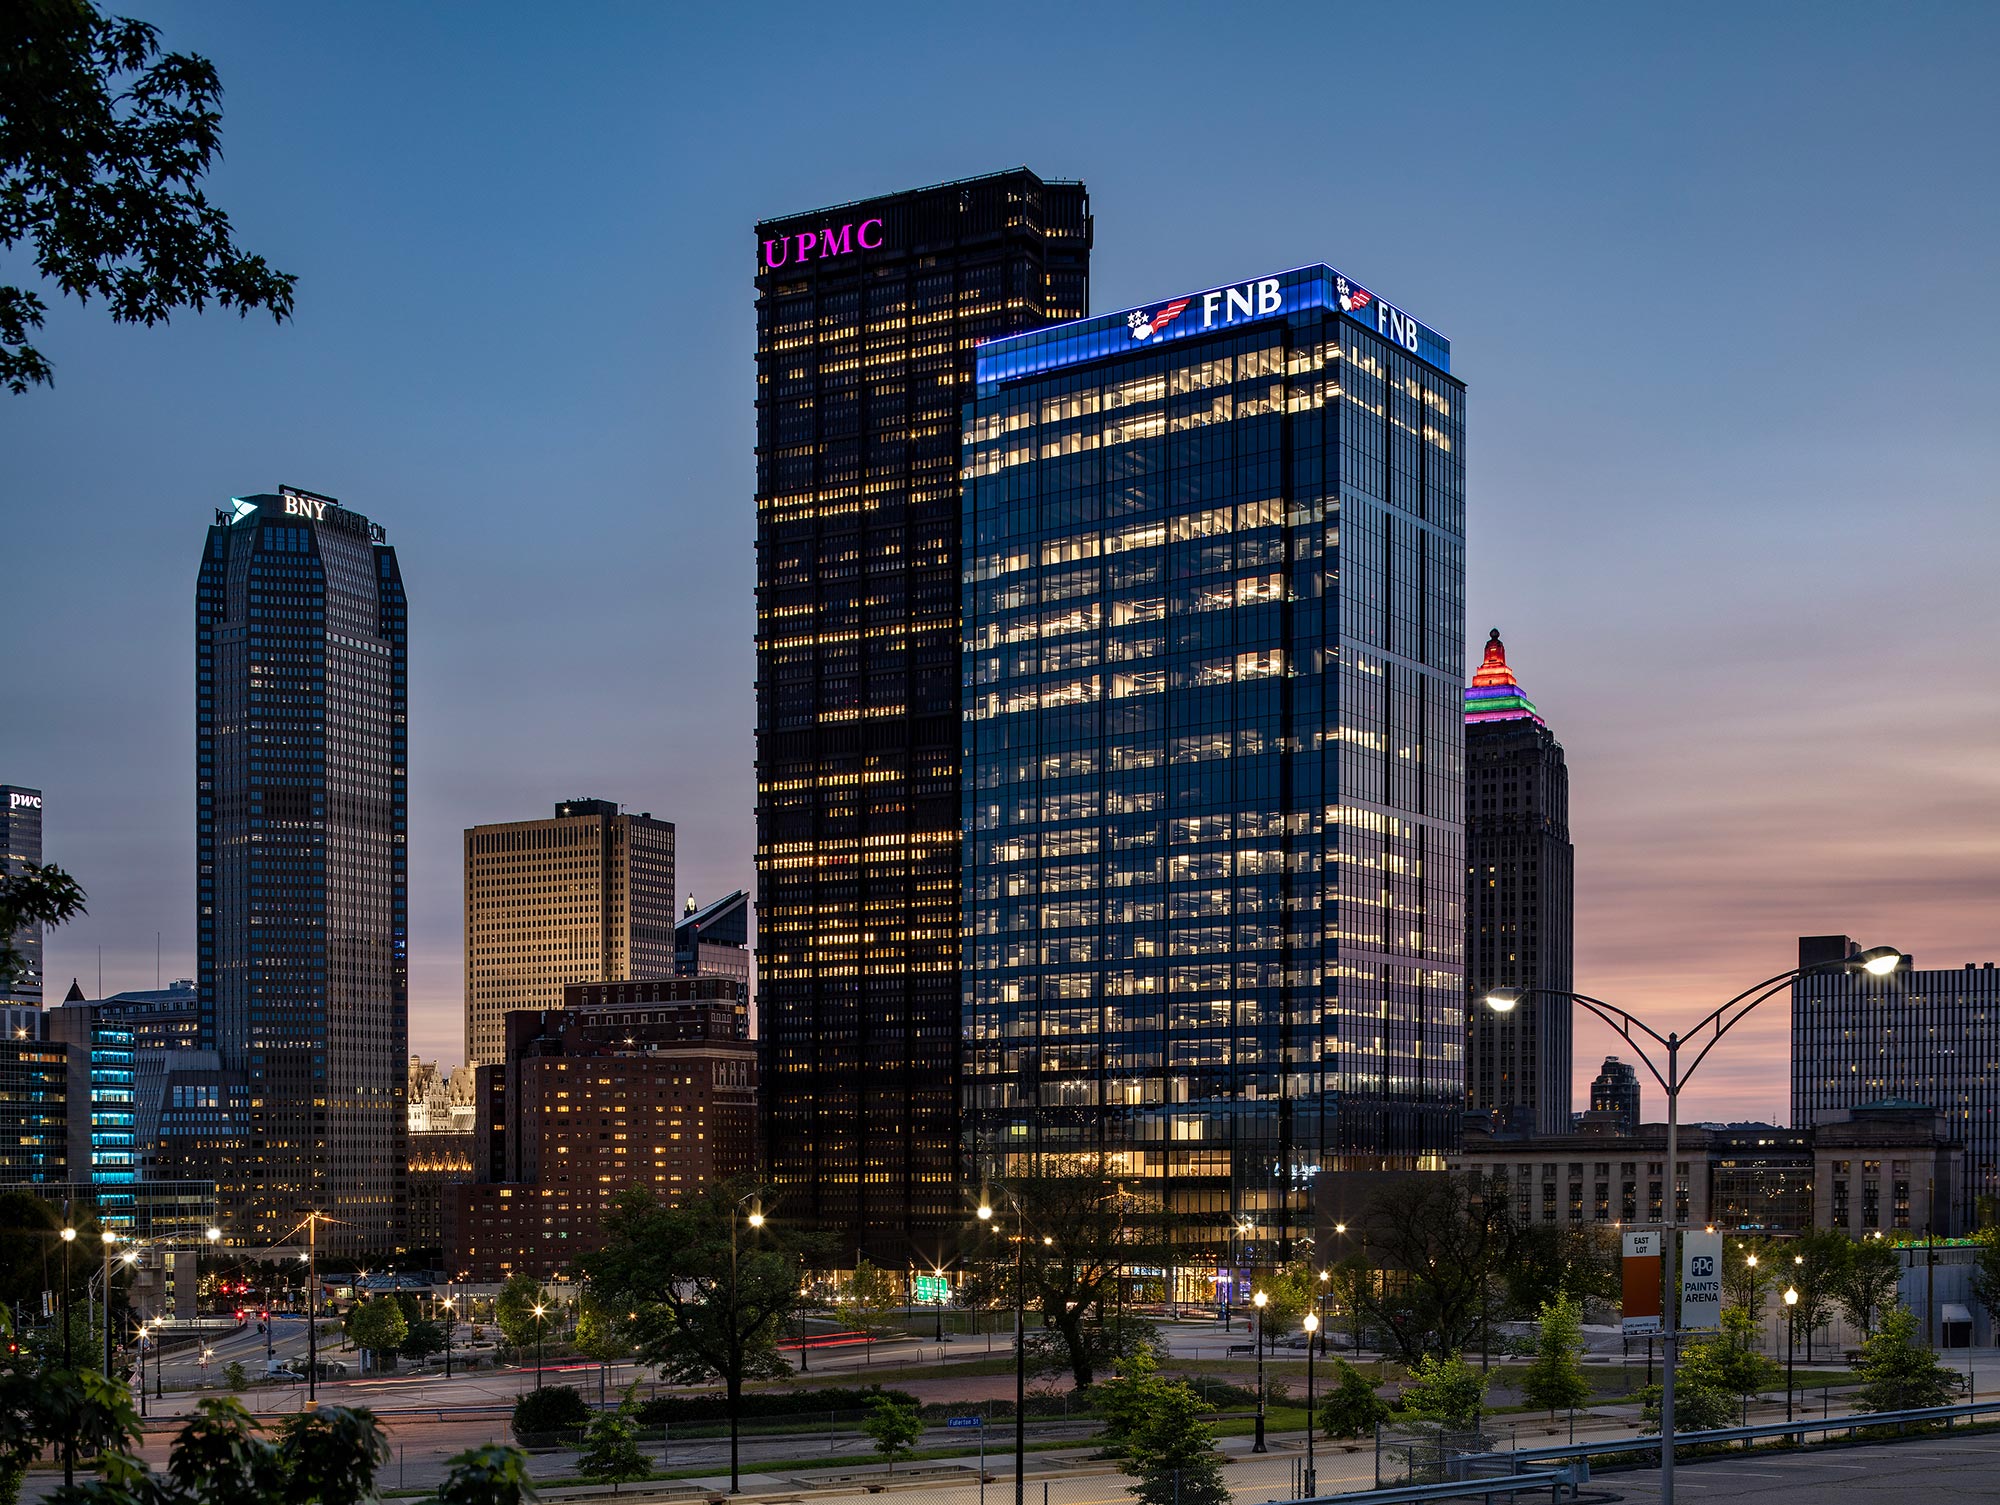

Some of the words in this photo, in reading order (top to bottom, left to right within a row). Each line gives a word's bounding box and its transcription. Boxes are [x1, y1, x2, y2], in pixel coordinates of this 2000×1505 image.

[763, 218, 883, 268] UPMC
[1202, 278, 1282, 328] FNB
[1377, 301, 1419, 353] FNB
[284, 495, 327, 521] BNY
[9, 792, 42, 810] pwc
[1636, 1246, 1647, 1254] LOT
[1692, 1258, 1713, 1275] PPG
[1684, 1281, 1719, 1291] PAINTS
[1685, 1293, 1718, 1303] ARENA
